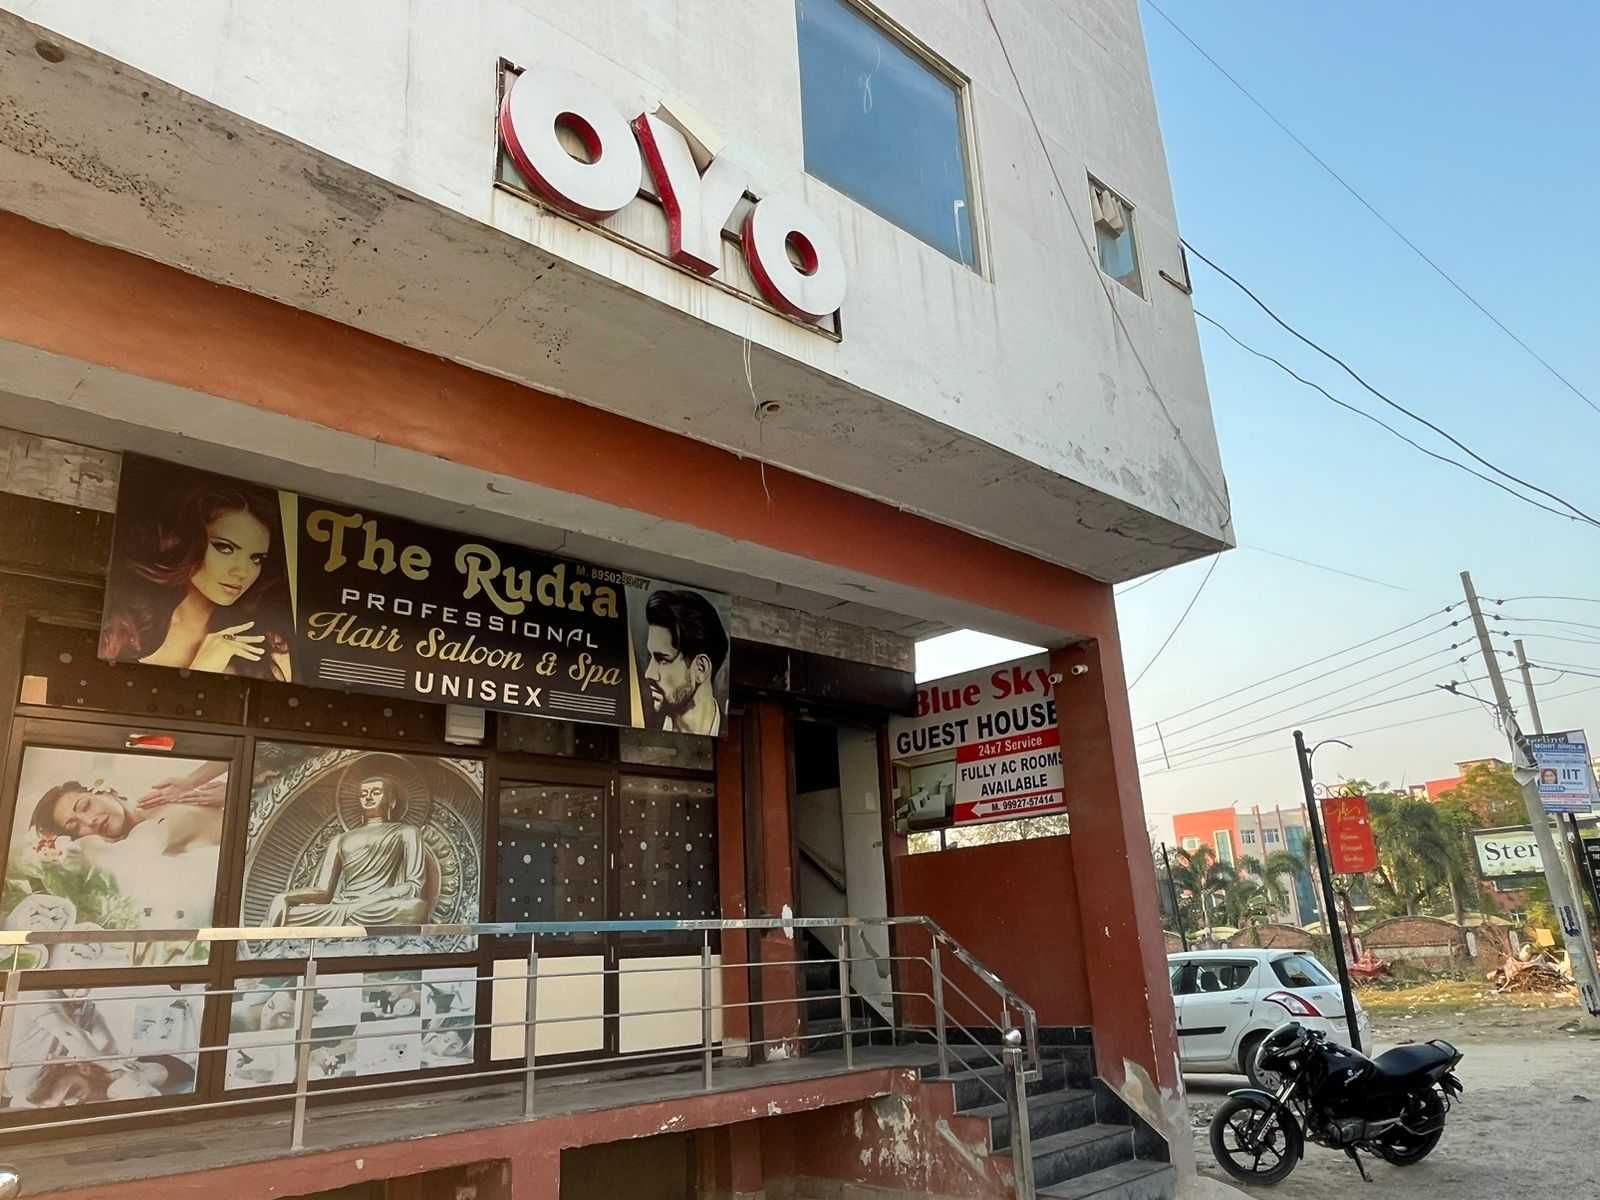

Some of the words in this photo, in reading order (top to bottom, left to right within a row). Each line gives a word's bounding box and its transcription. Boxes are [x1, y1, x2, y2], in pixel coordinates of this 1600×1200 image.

[501, 67, 847, 323] OYO
[306, 510, 432, 581] The
[455, 543, 619, 619] Rudra
[341, 588, 599, 649] PROFESSIONAL
[307, 611, 404, 653] Hair
[416, 627, 525, 672] Saloon
[536, 651, 557, 677] &
[569, 652, 623, 692] Spa
[414, 671, 542, 708] UNISEX
[914, 685, 980, 717] Blue
[991, 665, 1055, 699] Sky
[896, 719, 969, 754] GUEST
[977, 701, 1057, 739] HOUSE
[978, 741, 1002, 756] 24x7
[1005, 736, 1042, 752] Service
[961, 763, 996, 781] FULLY
[1001, 760, 1017, 775] AC
[981, 773, 1048, 797] AVAILABLE
[1562, 768, 1581, 780] IIT
[991, 803, 1000, 811] M.
